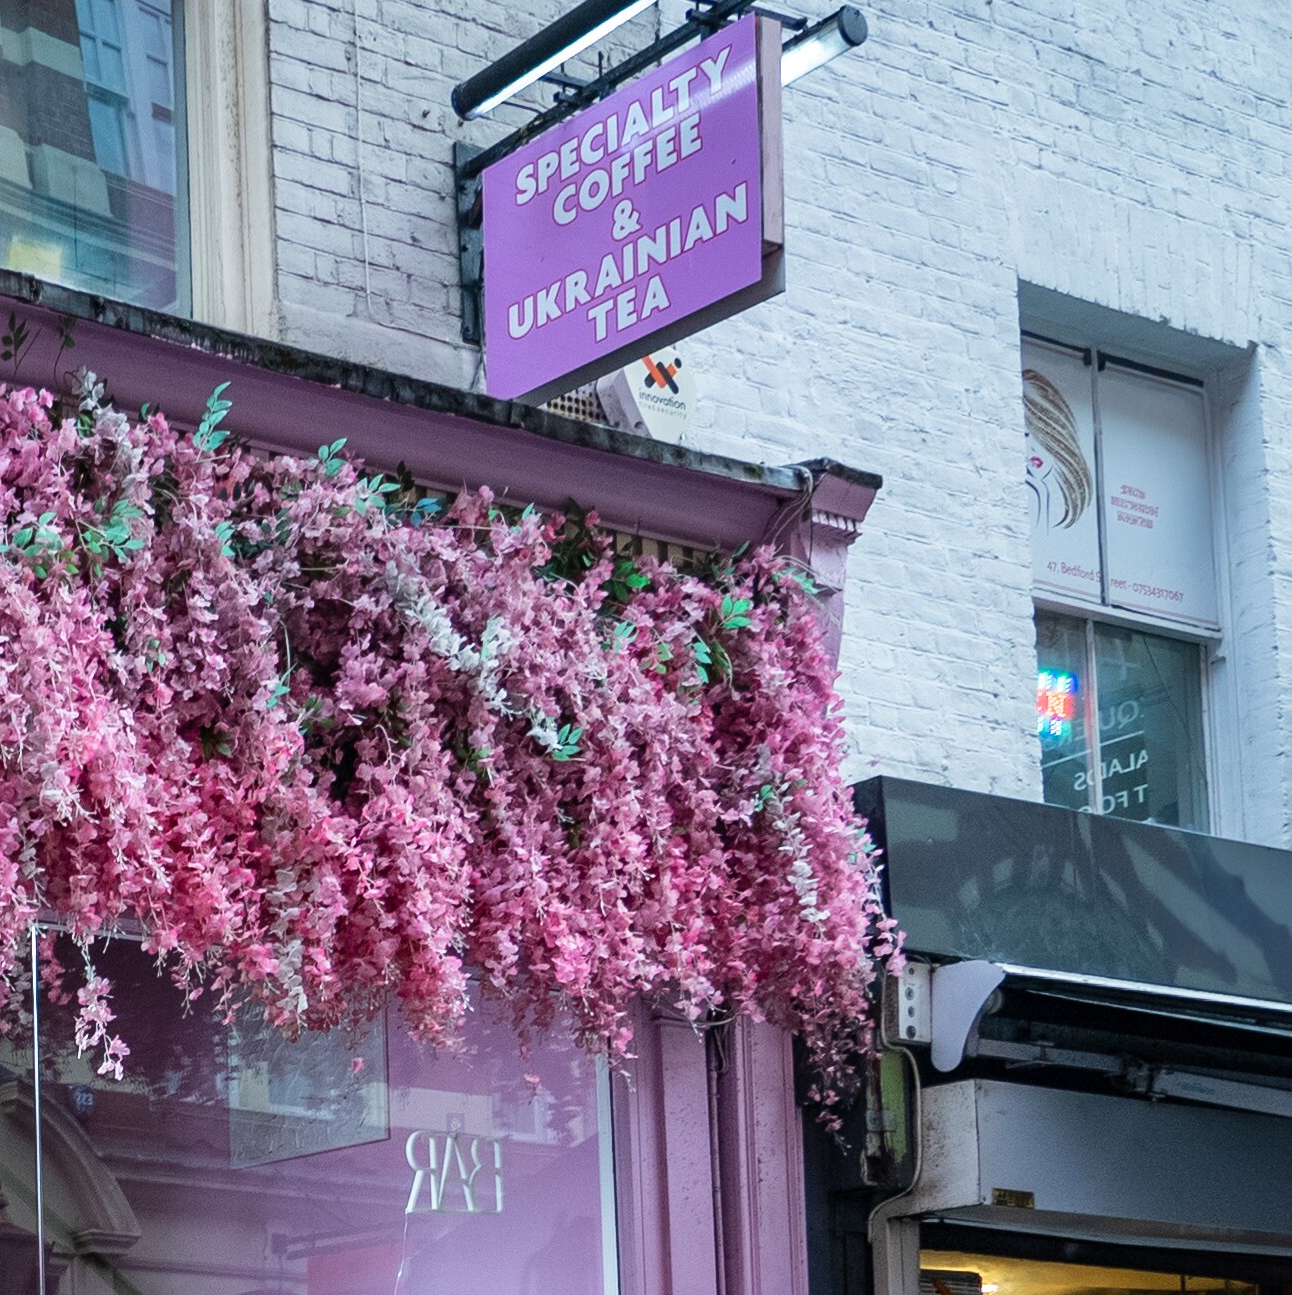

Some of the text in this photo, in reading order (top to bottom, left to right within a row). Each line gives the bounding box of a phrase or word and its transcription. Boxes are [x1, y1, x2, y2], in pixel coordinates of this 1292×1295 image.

[514, 48, 733, 207] SPECIALTY
[552, 112, 703, 226] COFFEE
[611, 200, 642, 240] &
[507, 182, 749, 340] UKRAINIAN
[586, 273, 670, 343] TEA
[639, 387, 687, 411] innovation
[1061, 562, 1095, 581] Bedford
